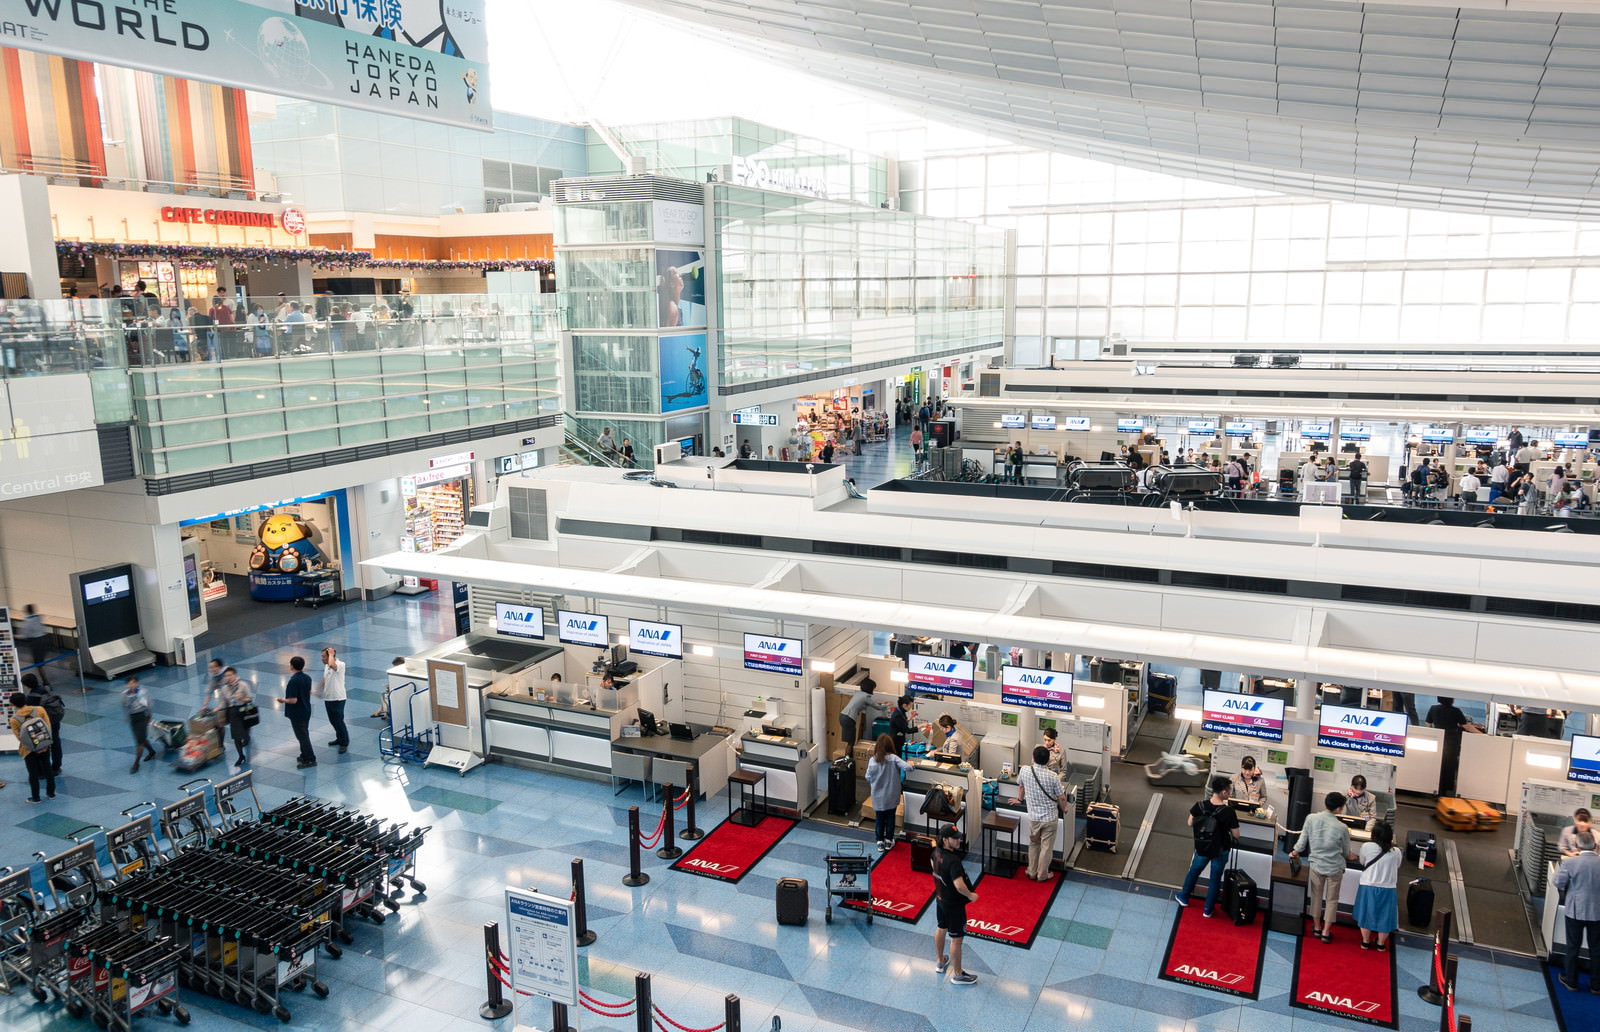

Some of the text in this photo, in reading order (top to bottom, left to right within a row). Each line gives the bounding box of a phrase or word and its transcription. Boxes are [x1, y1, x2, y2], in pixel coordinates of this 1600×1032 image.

[345, 40, 436, 75] HANEDA
[347, 59, 437, 92] TOKYO
[350, 79, 438, 109] JAPAN
[161, 206, 203, 224] CAFE
[204, 209, 278, 228] CARDINAL
[1, 472, 94, 495] Central 中央
[504, 610, 523, 621] ANA
[567, 619, 587, 630] ANA
[638, 628, 660, 640] ANA
[758, 641, 777, 650] ANA
[924, 662, 945, 672] ANA
[1019, 674, 1042, 684] ANA
[937, 687, 952, 695] before
[1222, 699, 1249, 711] ANA
[1340, 714, 1369, 726] ANA
[1213, 725, 1237, 733] minutes
[1237, 728, 1257, 736] before
[1258, 730, 1282, 739] departu
[1331, 740, 1350, 748] closes
[1362, 744, 1388, 753] check-in
[684, 859, 720, 870] ANA
[966, 918, 1001, 933] ANA
[1173, 964, 1218, 980] ANA
[1175, 977, 1231, 993] STAR ALLIANCE
[1305, 991, 1353, 1009] ANA
[1307, 1004, 1369, 1022] STAR ALLIANCE
